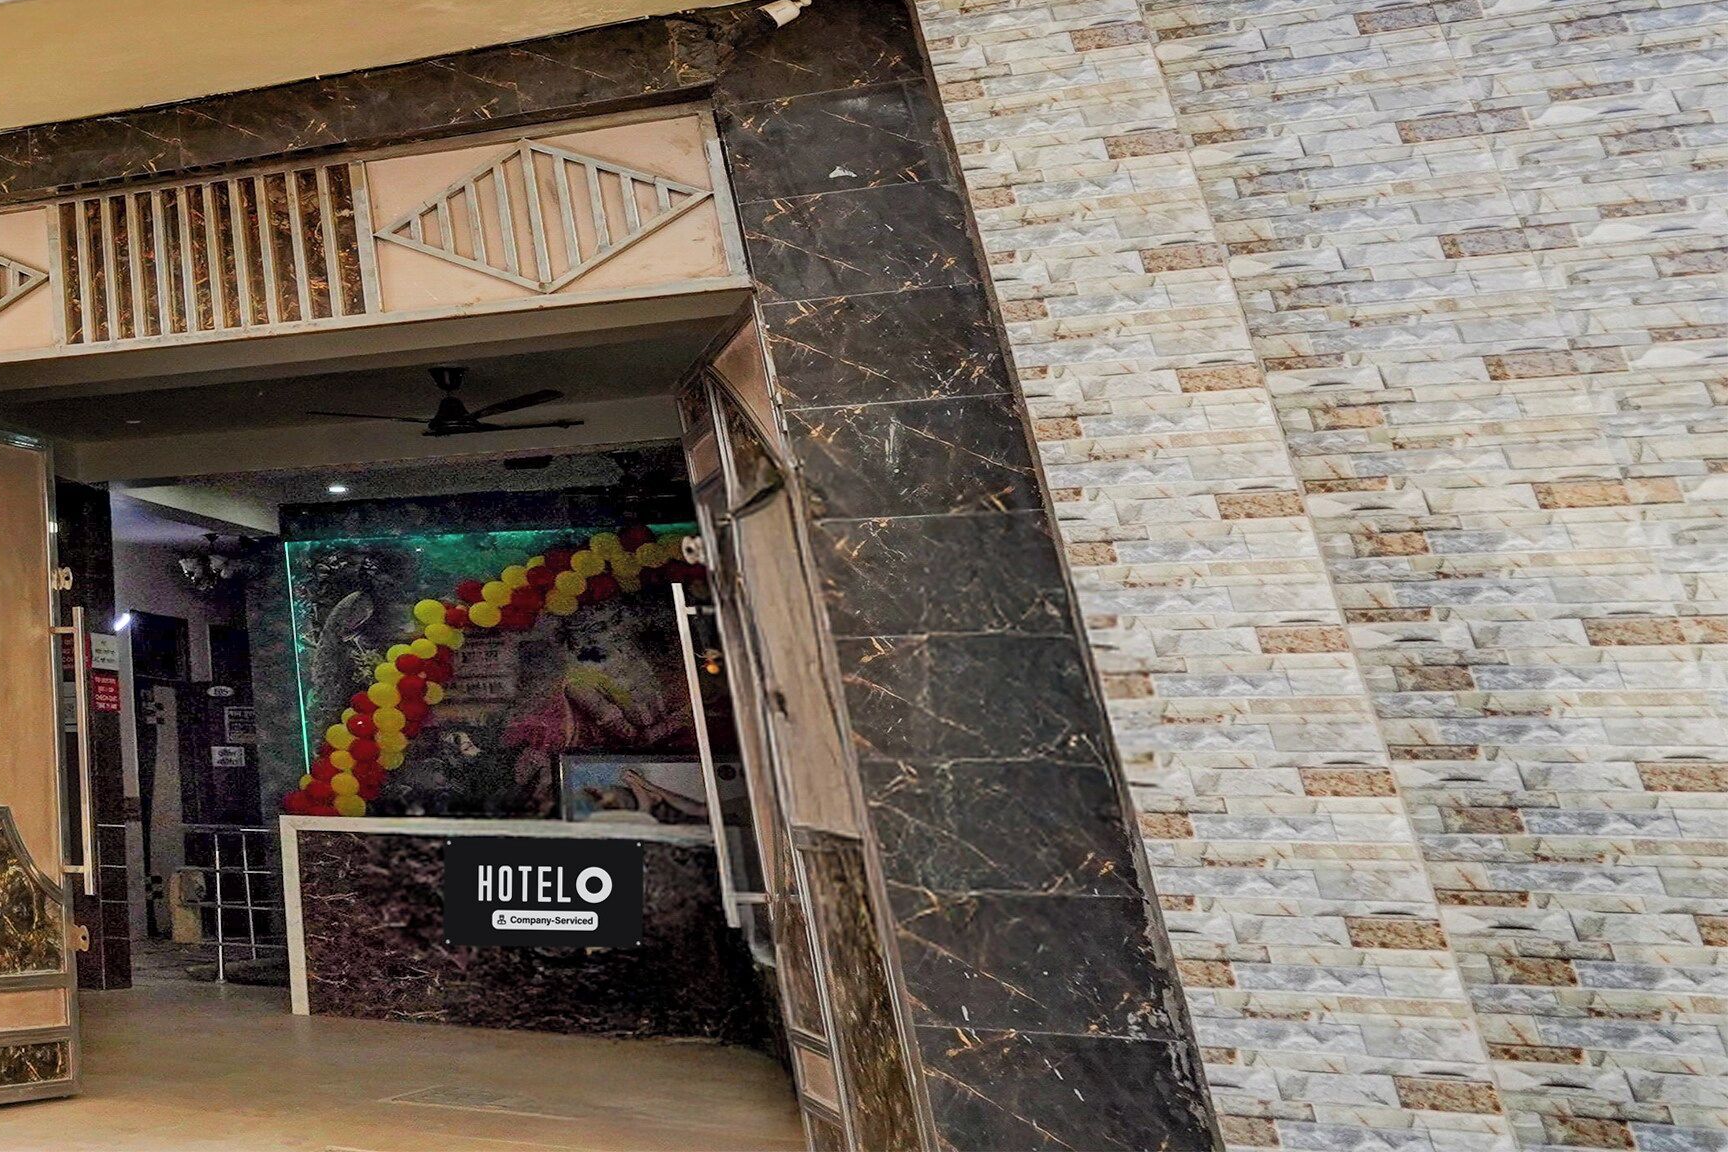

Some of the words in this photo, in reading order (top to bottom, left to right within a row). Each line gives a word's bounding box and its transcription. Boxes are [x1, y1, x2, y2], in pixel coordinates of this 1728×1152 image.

[478, 865, 571, 903] HOTEL
[575, 866, 613, 904] O
[510, 915, 593, 925] Company-Serviced
